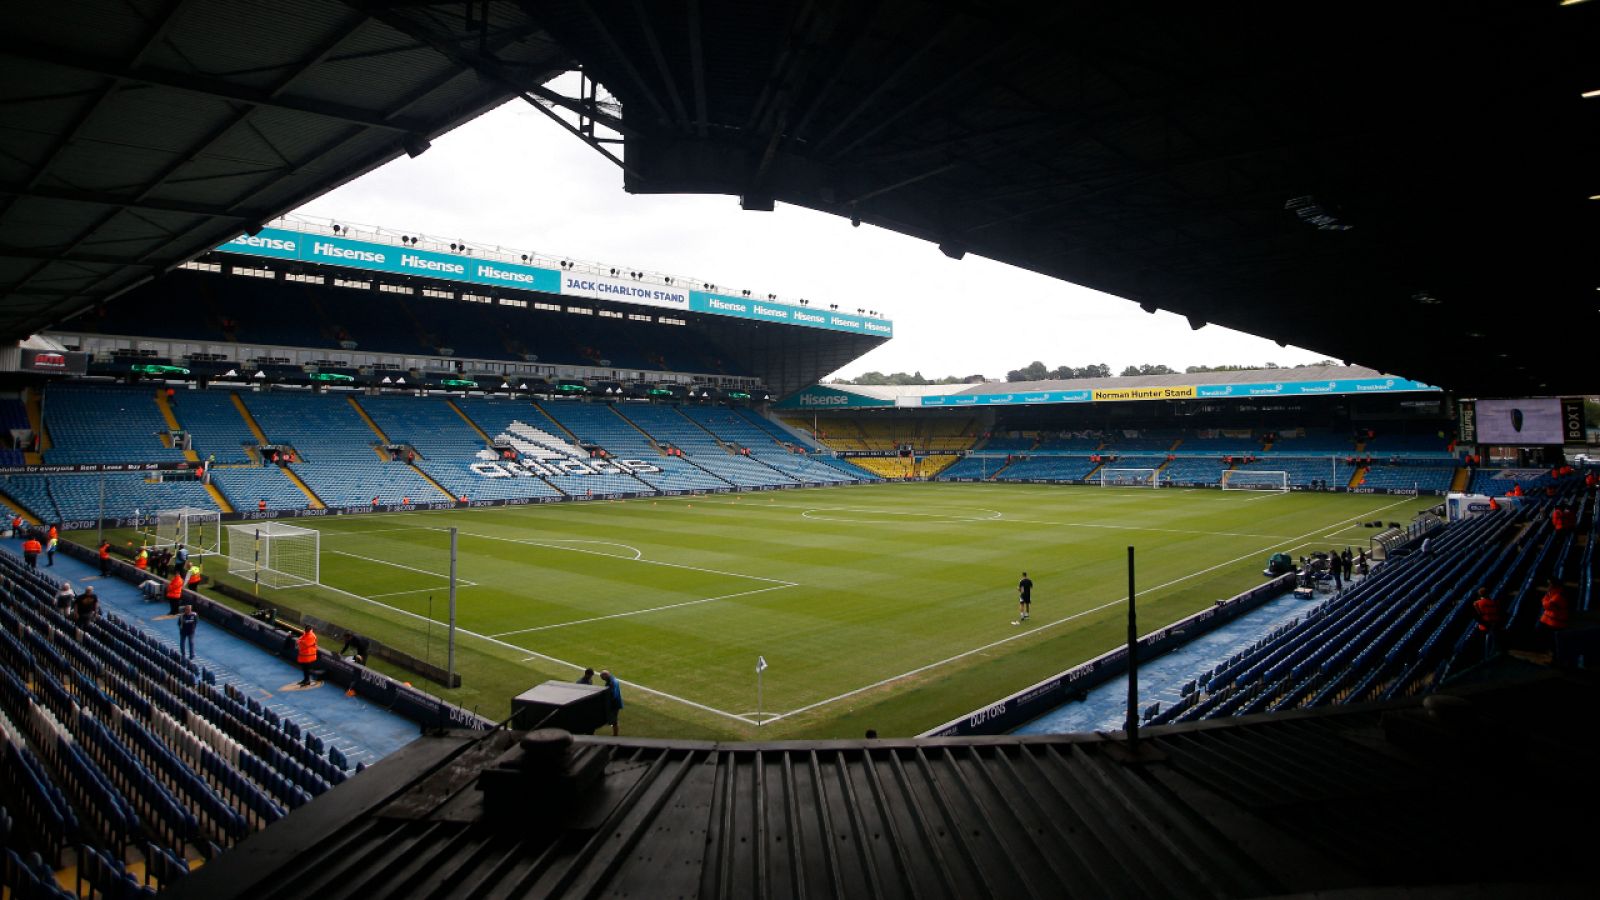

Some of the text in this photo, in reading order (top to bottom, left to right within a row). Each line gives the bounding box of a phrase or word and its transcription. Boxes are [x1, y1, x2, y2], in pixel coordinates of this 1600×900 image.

[229, 234, 296, 251] sense
[313, 241, 385, 264] Hisense
[400, 254, 465, 274] Hisense
[477, 265, 534, 284] Hisense
[567, 279, 685, 303] JACK CHARLTON STAND
[709, 298, 747, 313] Hisense
[753, 305, 788, 318] Hisense
[793, 311, 825, 324] Hisense
[830, 316, 860, 328] Hisense
[864, 321, 891, 334] Hisense
[799, 393, 848, 405] Hisense
[1095, 388, 1192, 399] Norman Hunter Stand
[1567, 405, 1580, 437] BOXT
[127, 517, 160, 527] SBOOP
[970, 700, 1006, 728] DUFTONS
